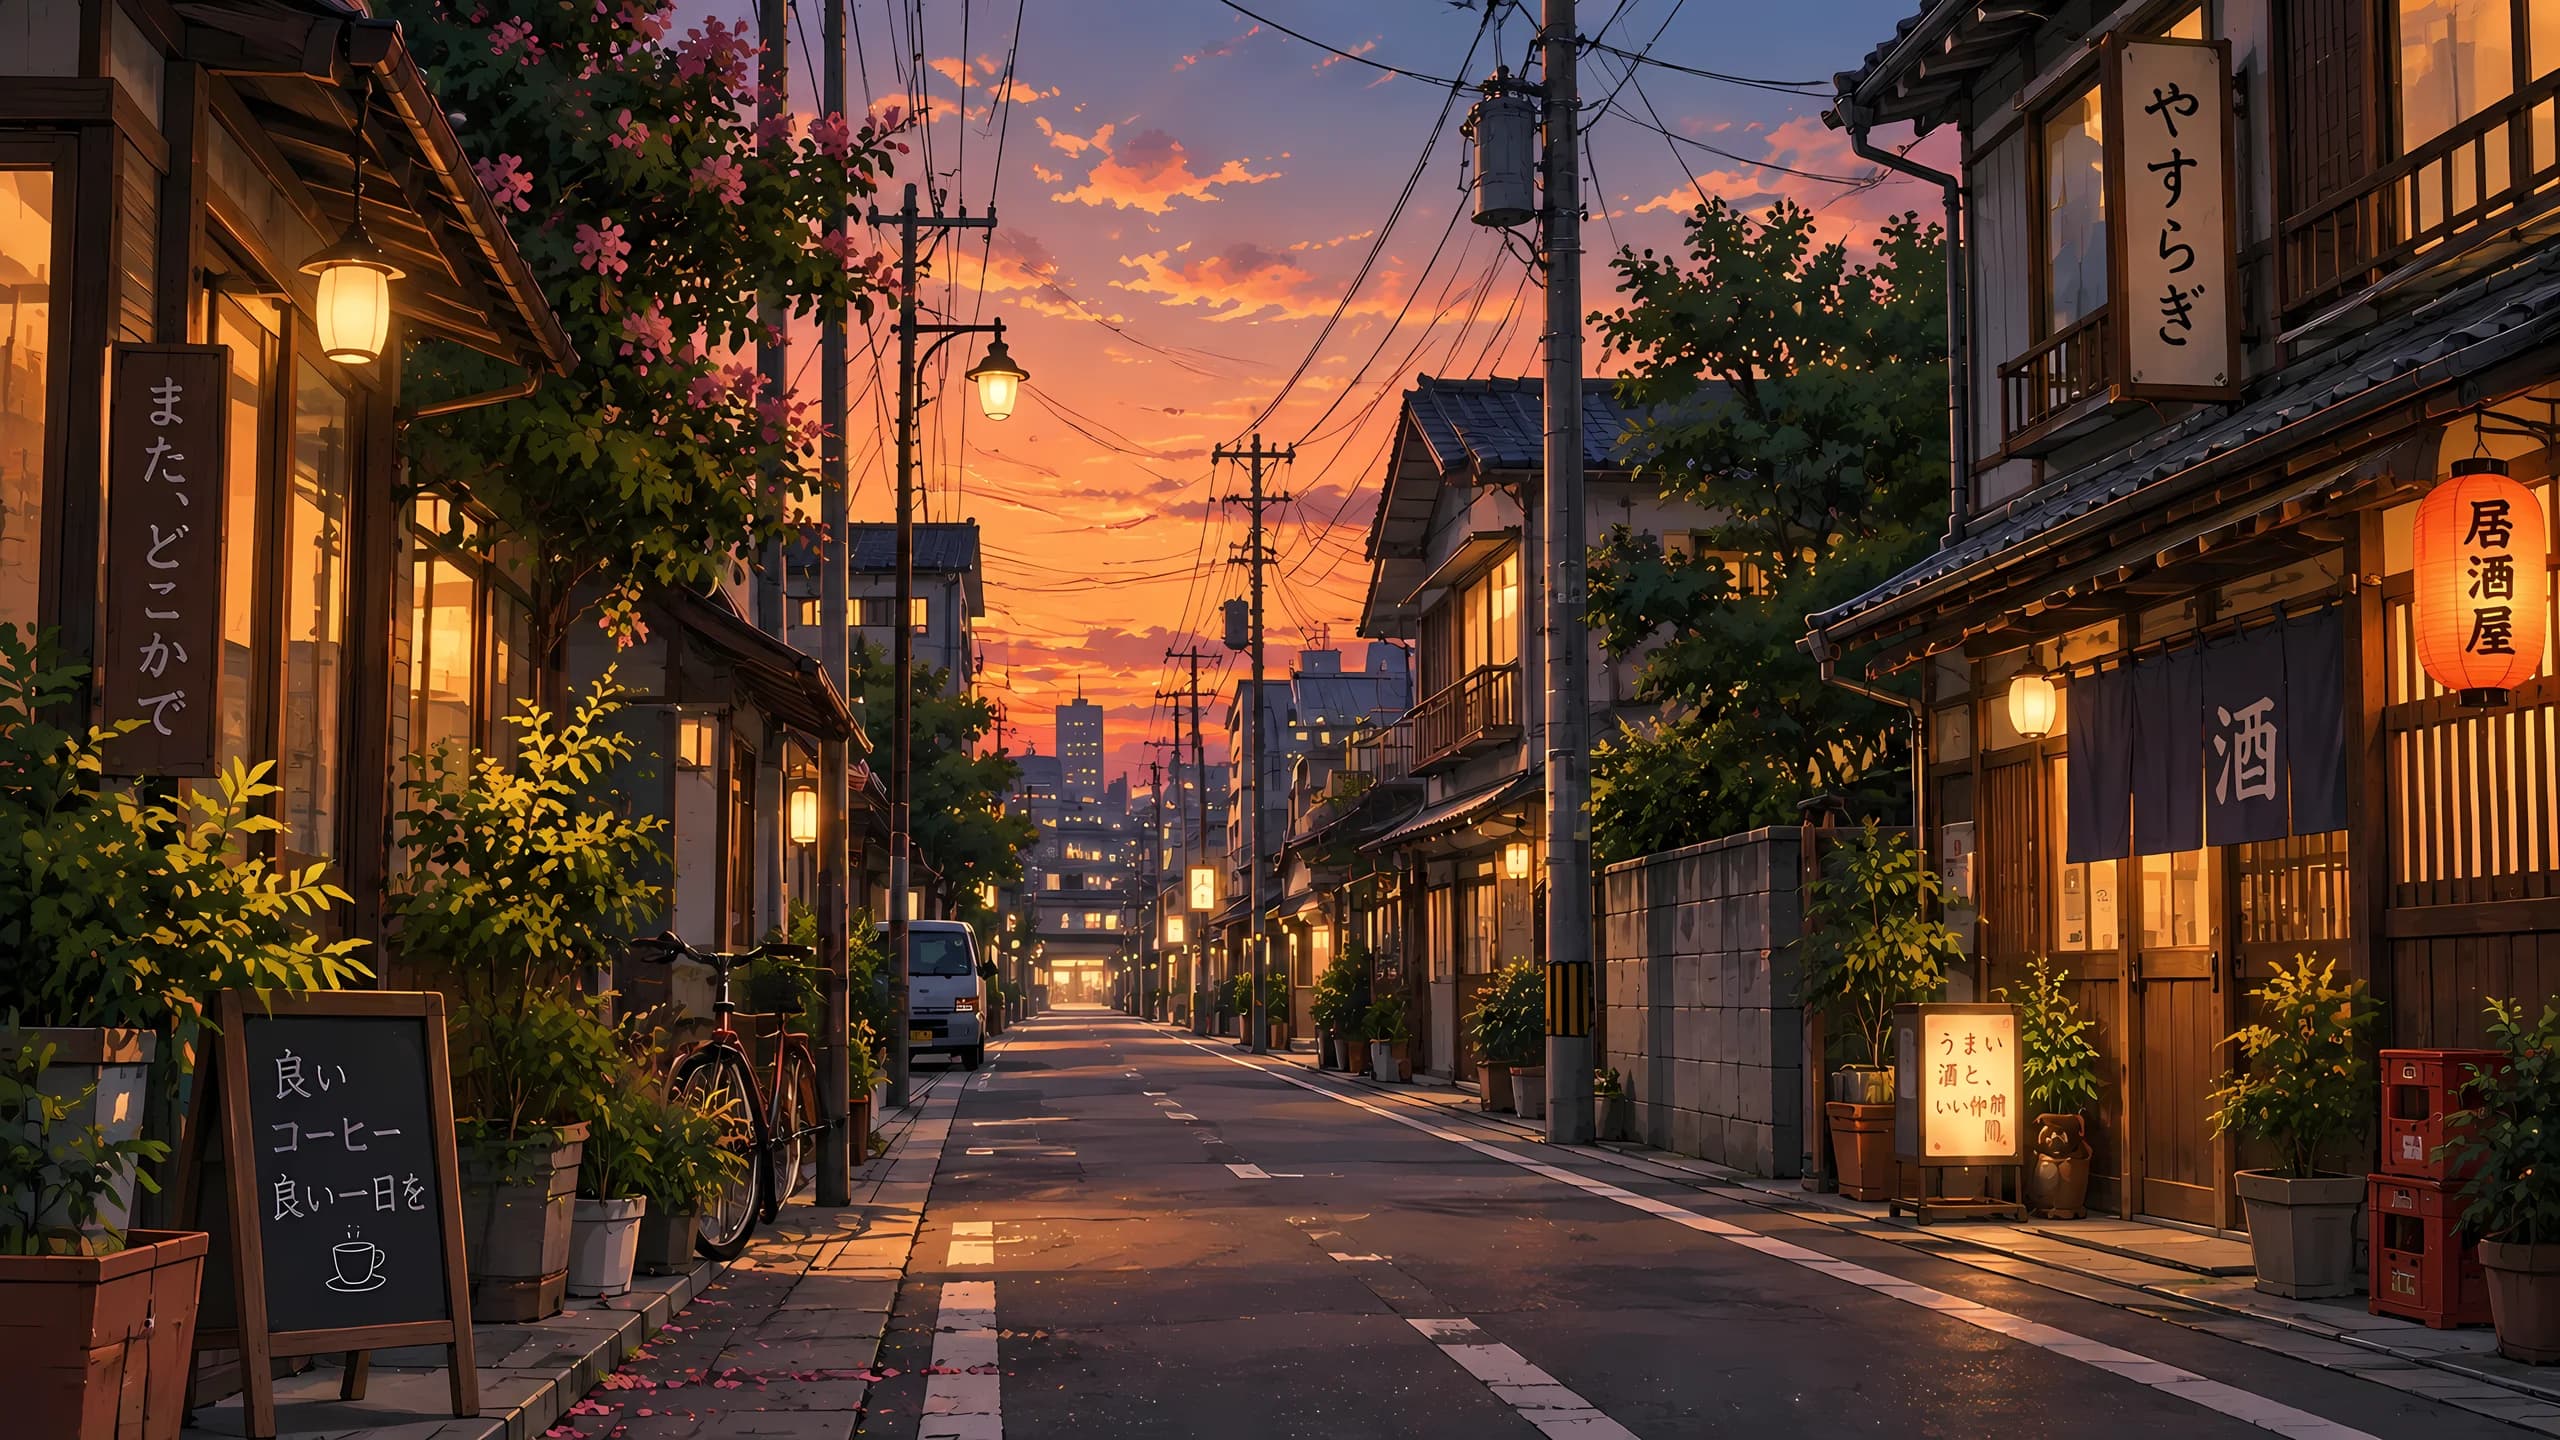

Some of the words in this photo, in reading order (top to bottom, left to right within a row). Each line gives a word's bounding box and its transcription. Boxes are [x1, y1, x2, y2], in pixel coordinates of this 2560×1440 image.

[2145, 82, 2205, 347] やすらぎ
[138, 376, 190, 736] また、どこかで
[2463, 499, 2516, 656] 居酒屋
[2212, 697, 2277, 806] 酒
[1940, 1032, 2003, 1056] うまい
[276, 1049, 346, 1099] 良い
[1938, 1063, 1991, 1087] 酒と、
[271, 1117, 401, 1152] コーヒー
[274, 1173, 425, 1221] 良い一日を
